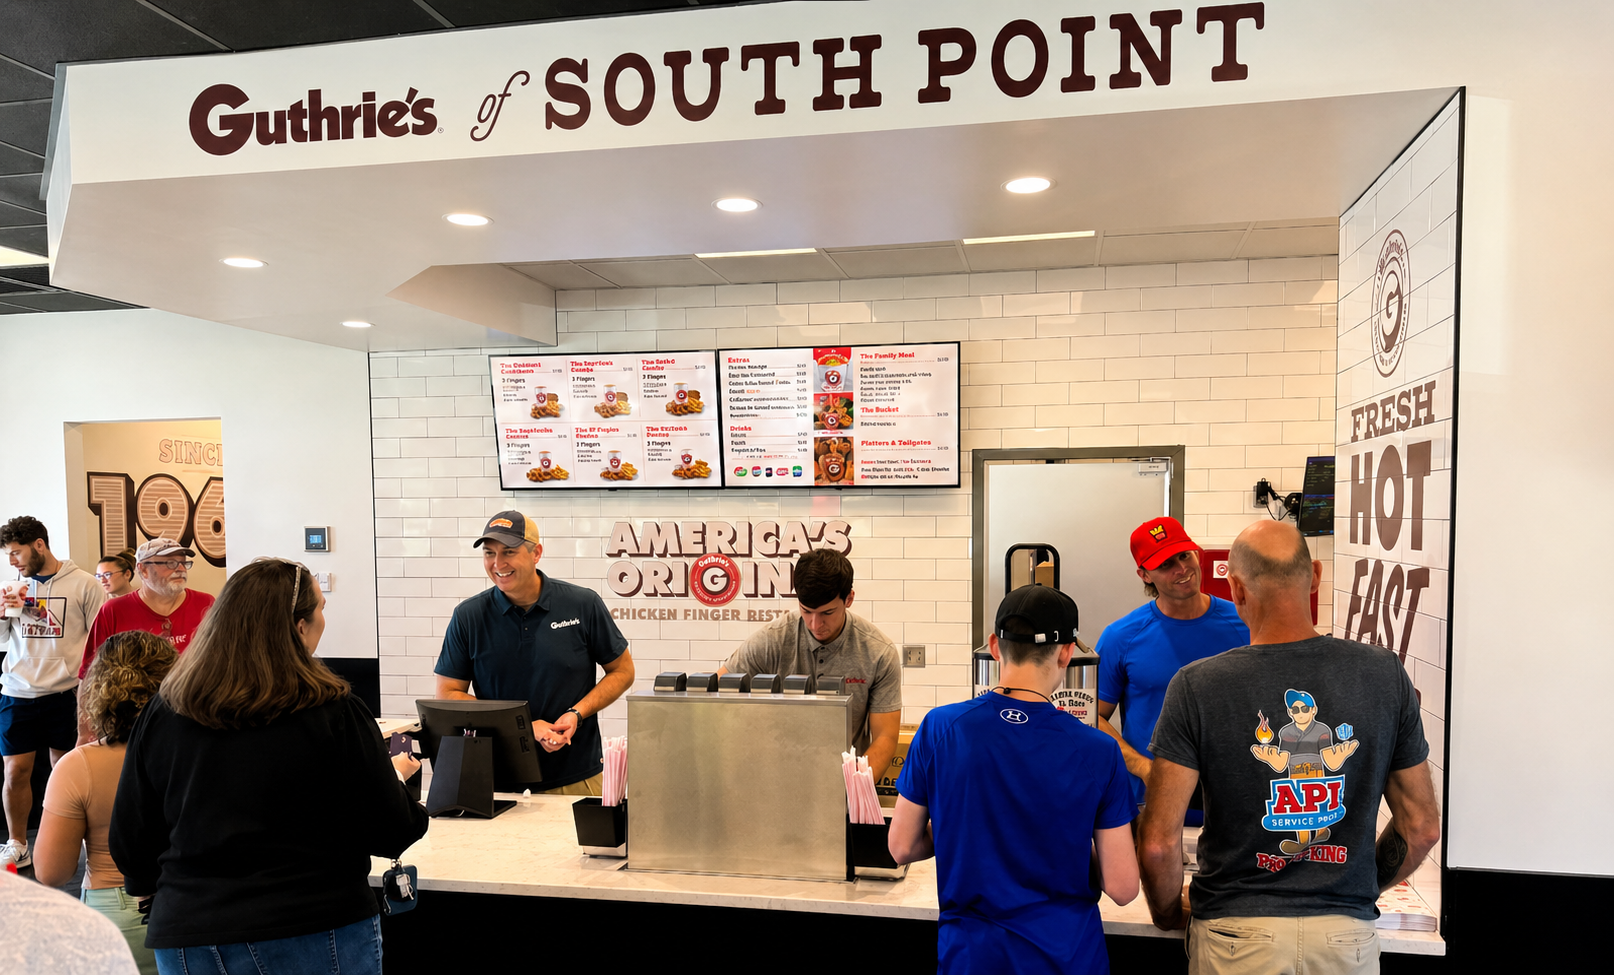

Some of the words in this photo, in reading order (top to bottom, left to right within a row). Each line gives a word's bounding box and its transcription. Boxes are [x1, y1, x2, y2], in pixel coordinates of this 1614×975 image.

[189, 83, 438, 156] Guthrie's
[470, 70, 531, 141] of
[545, 34, 883, 130] SOUTH
[918, 2, 1265, 104] POINT
[1351, 380, 1436, 443] FRESH
[1350, 440, 1432, 551] HOT
[606, 520, 852, 558] AMERICA'S
[610, 607, 677, 620] CHICKEN
[683, 609, 741, 621] FINGER
[1345, 558, 1430, 667] FAST
[1271, 817, 1314, 827] SERVICE
[1273, 782, 1341, 814] API
